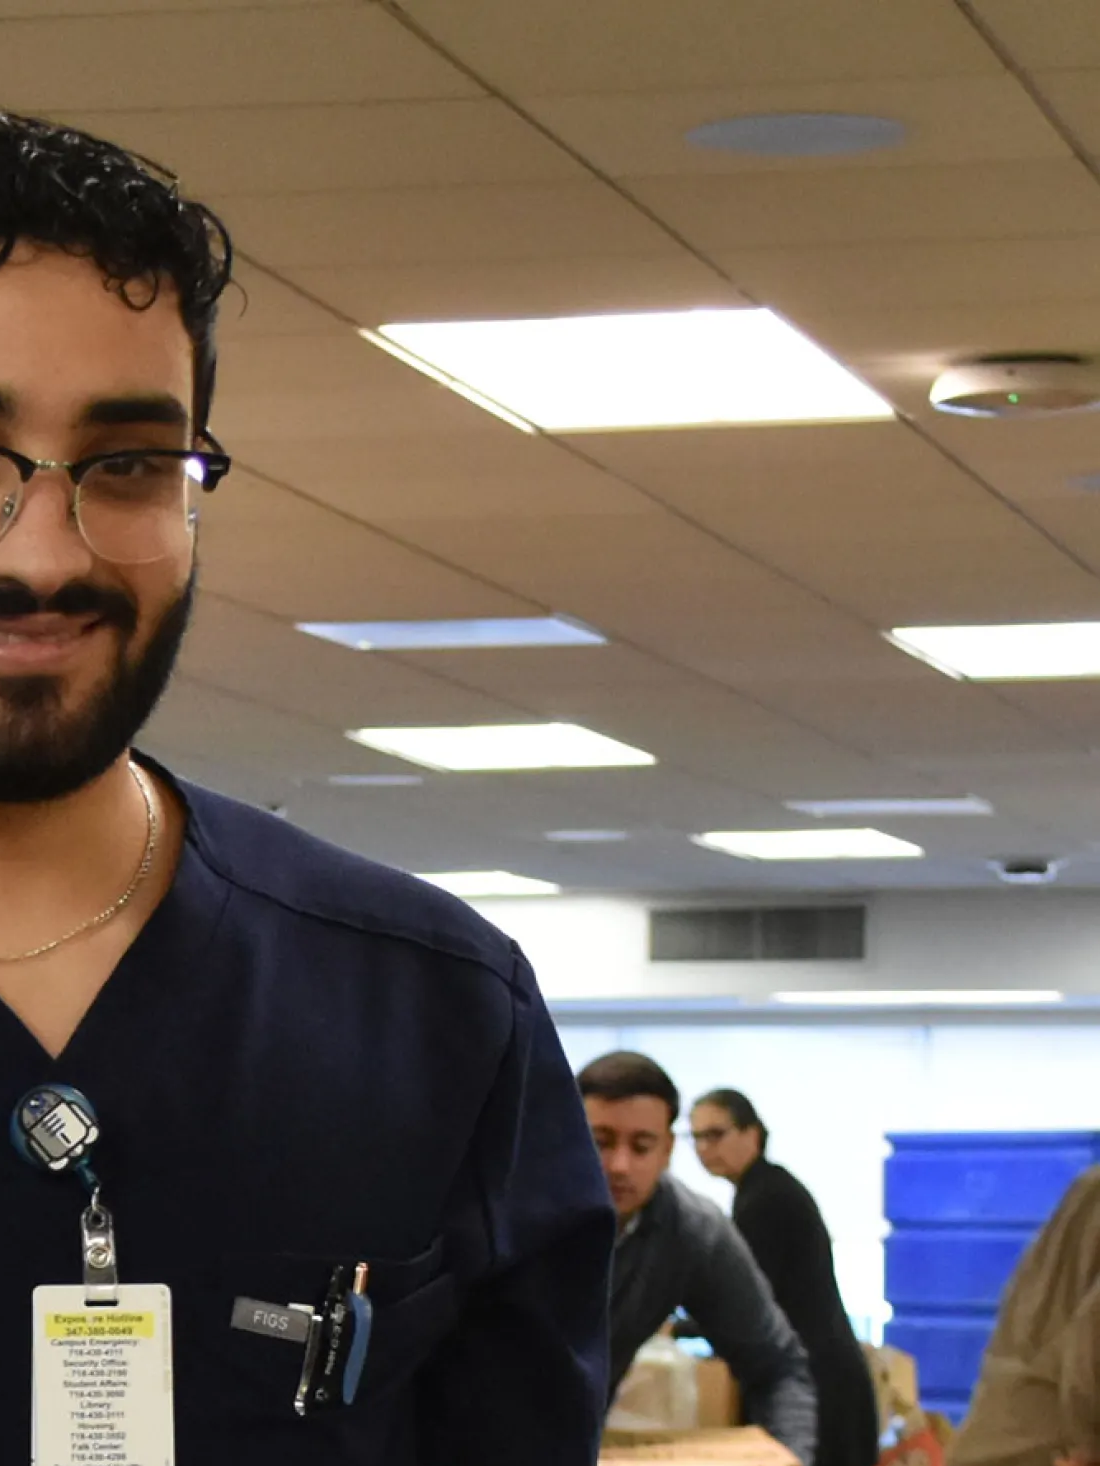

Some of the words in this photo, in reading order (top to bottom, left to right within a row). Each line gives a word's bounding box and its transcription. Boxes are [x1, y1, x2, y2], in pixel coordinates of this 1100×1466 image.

[54, 1314, 103, 1324] Exposre
[253, 1309, 290, 1331] FIGS
[50, 1338, 87, 1348] Campus
